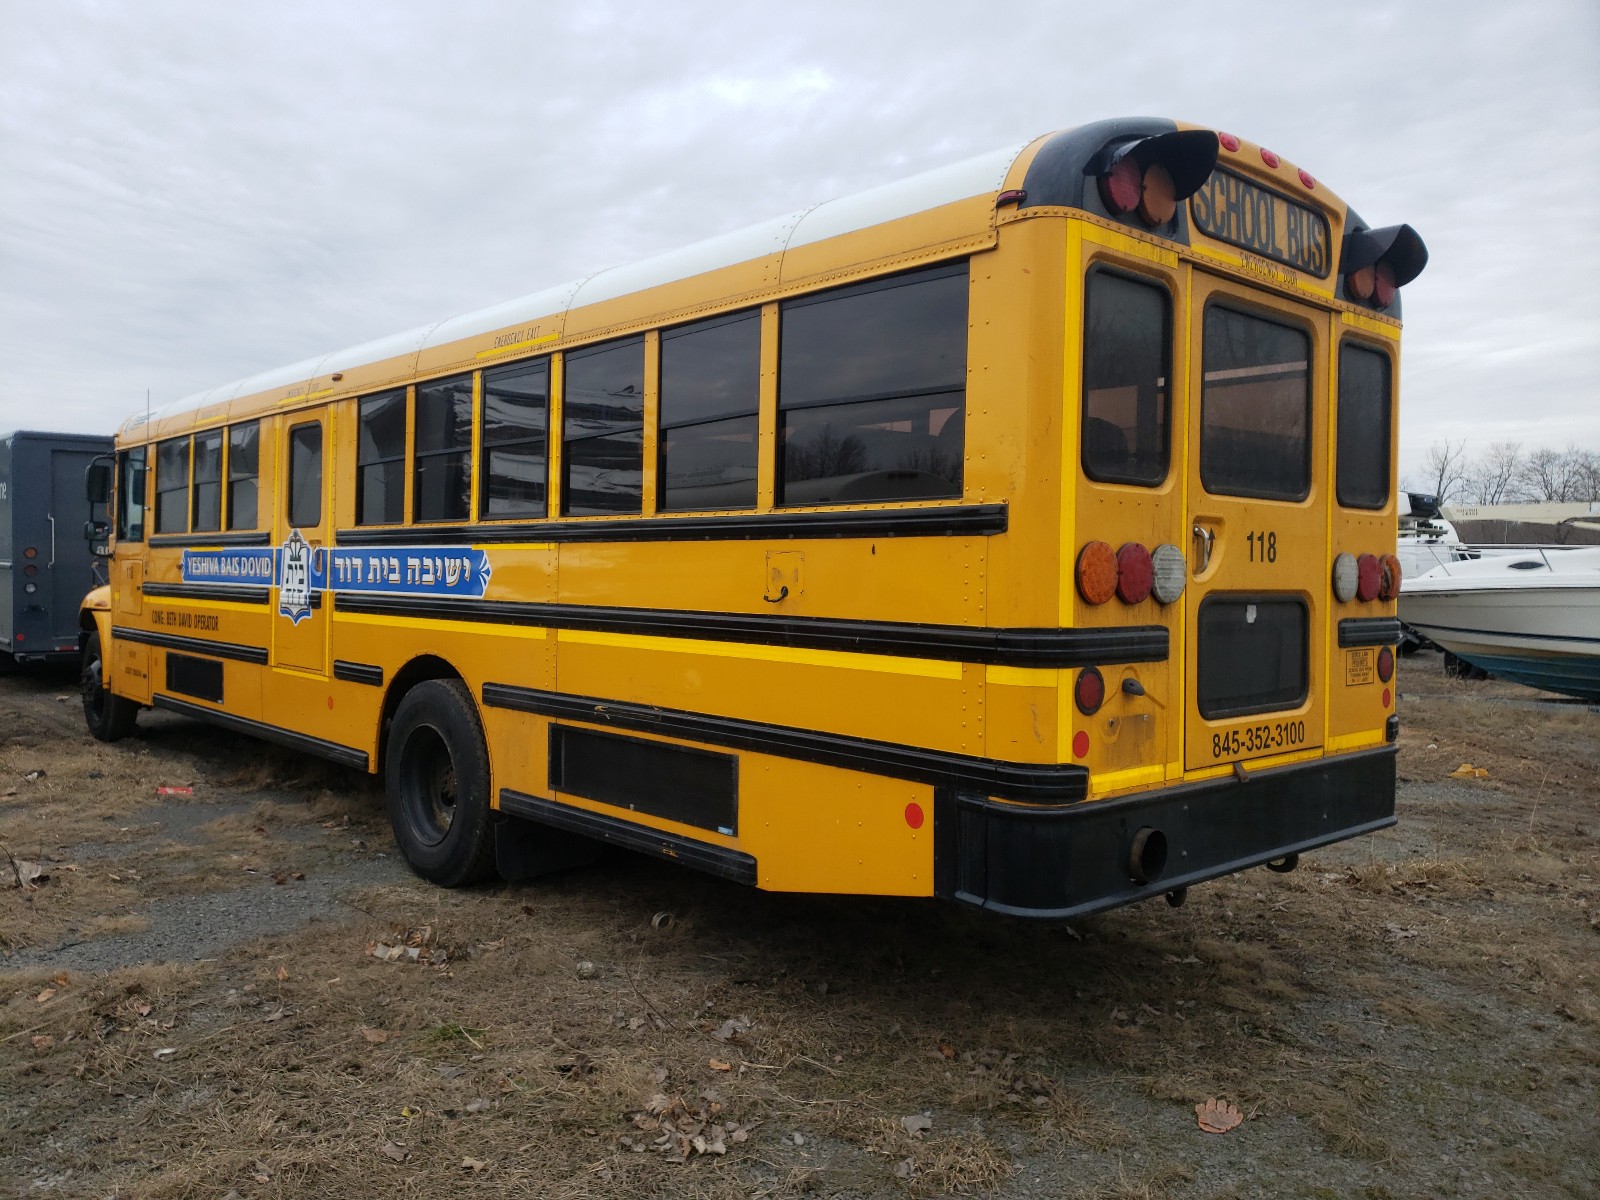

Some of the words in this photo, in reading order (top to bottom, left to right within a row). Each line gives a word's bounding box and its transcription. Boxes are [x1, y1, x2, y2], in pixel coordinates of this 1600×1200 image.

[1194, 171, 1283, 258] SCHOOL
[1287, 202, 1324, 274] BUS
[1240, 251, 1279, 280] EMERGENCY
[494, 330, 525, 349] EMERGENCY
[526, 325, 541, 341] EXIT
[1246, 530, 1277, 564] 118
[187, 556, 219, 576] YESHIVA
[220, 556, 240, 577] BAIS
[241, 556, 271, 578] DOVID
[334, 556, 362, 583] דוד
[367, 556, 401, 584] בית
[407, 556, 472, 587] ישיבה
[166, 610, 177, 627] BETH
[178, 612, 193, 629] DAVID
[193, 614, 219, 632] OPERATOR
[1212, 720, 1305, 759] 845-352-3100
